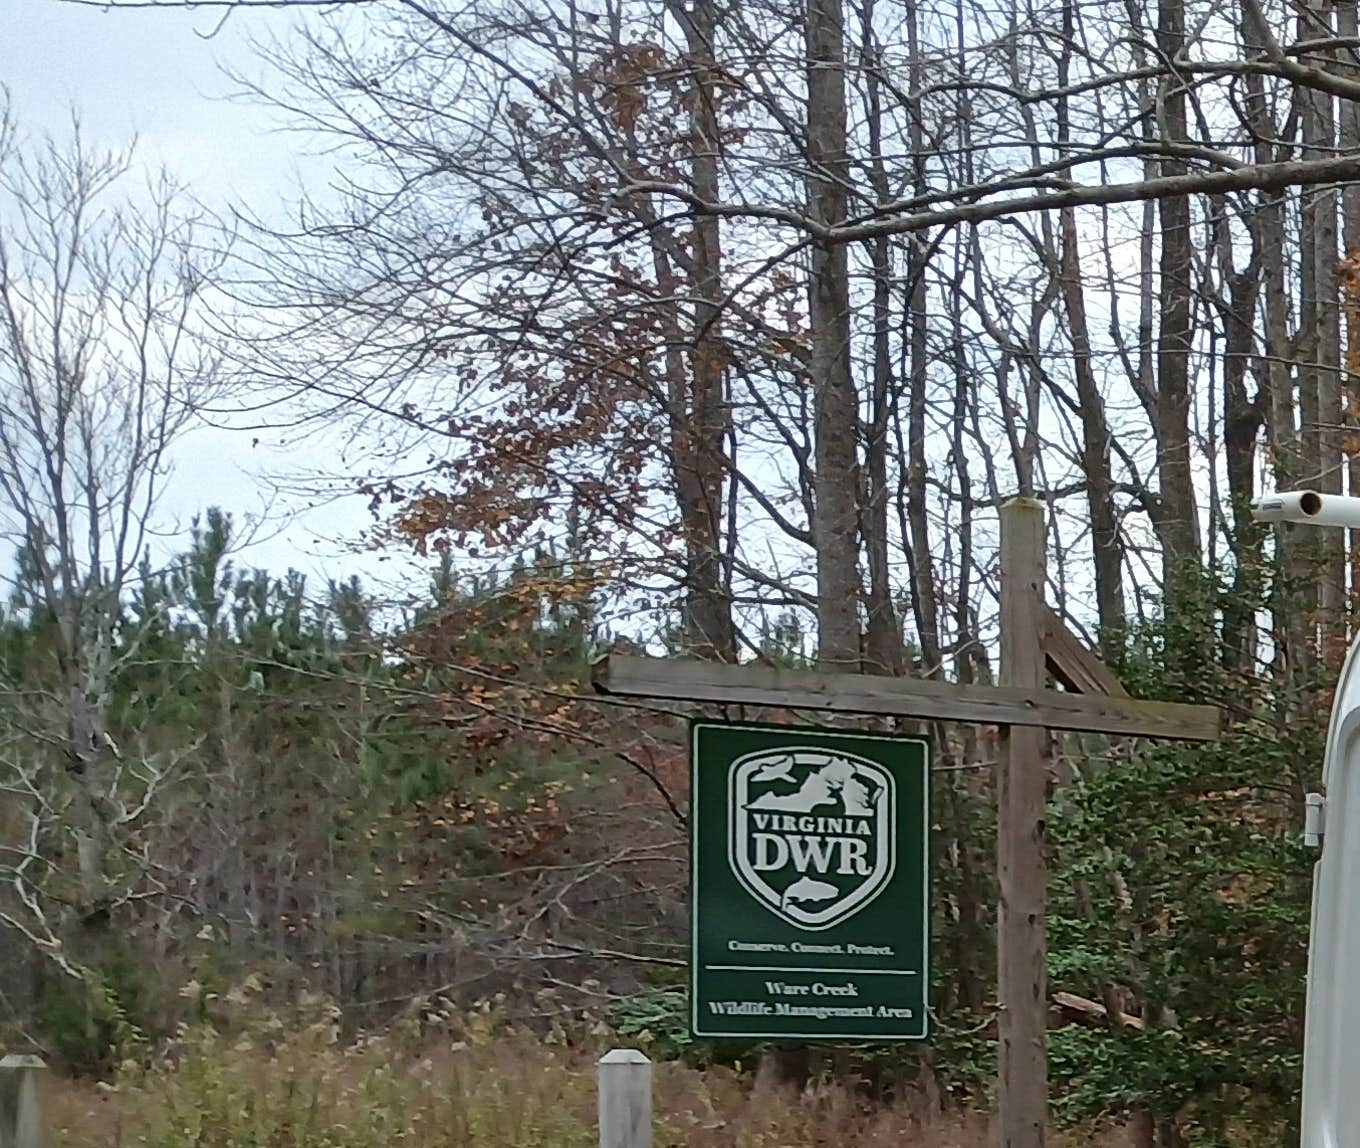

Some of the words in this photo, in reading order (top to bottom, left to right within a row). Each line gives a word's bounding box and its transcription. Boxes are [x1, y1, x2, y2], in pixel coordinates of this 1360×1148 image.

[752, 813, 872, 836] VIRGINIA
[752, 832, 874, 876] DWR
[765, 981, 810, 996] Ware
[812, 982, 859, 997] Creek
[708, 1001, 773, 1016] Wildlife
[775, 1003, 874, 1020] Management
[876, 1005, 913, 1019] Area
